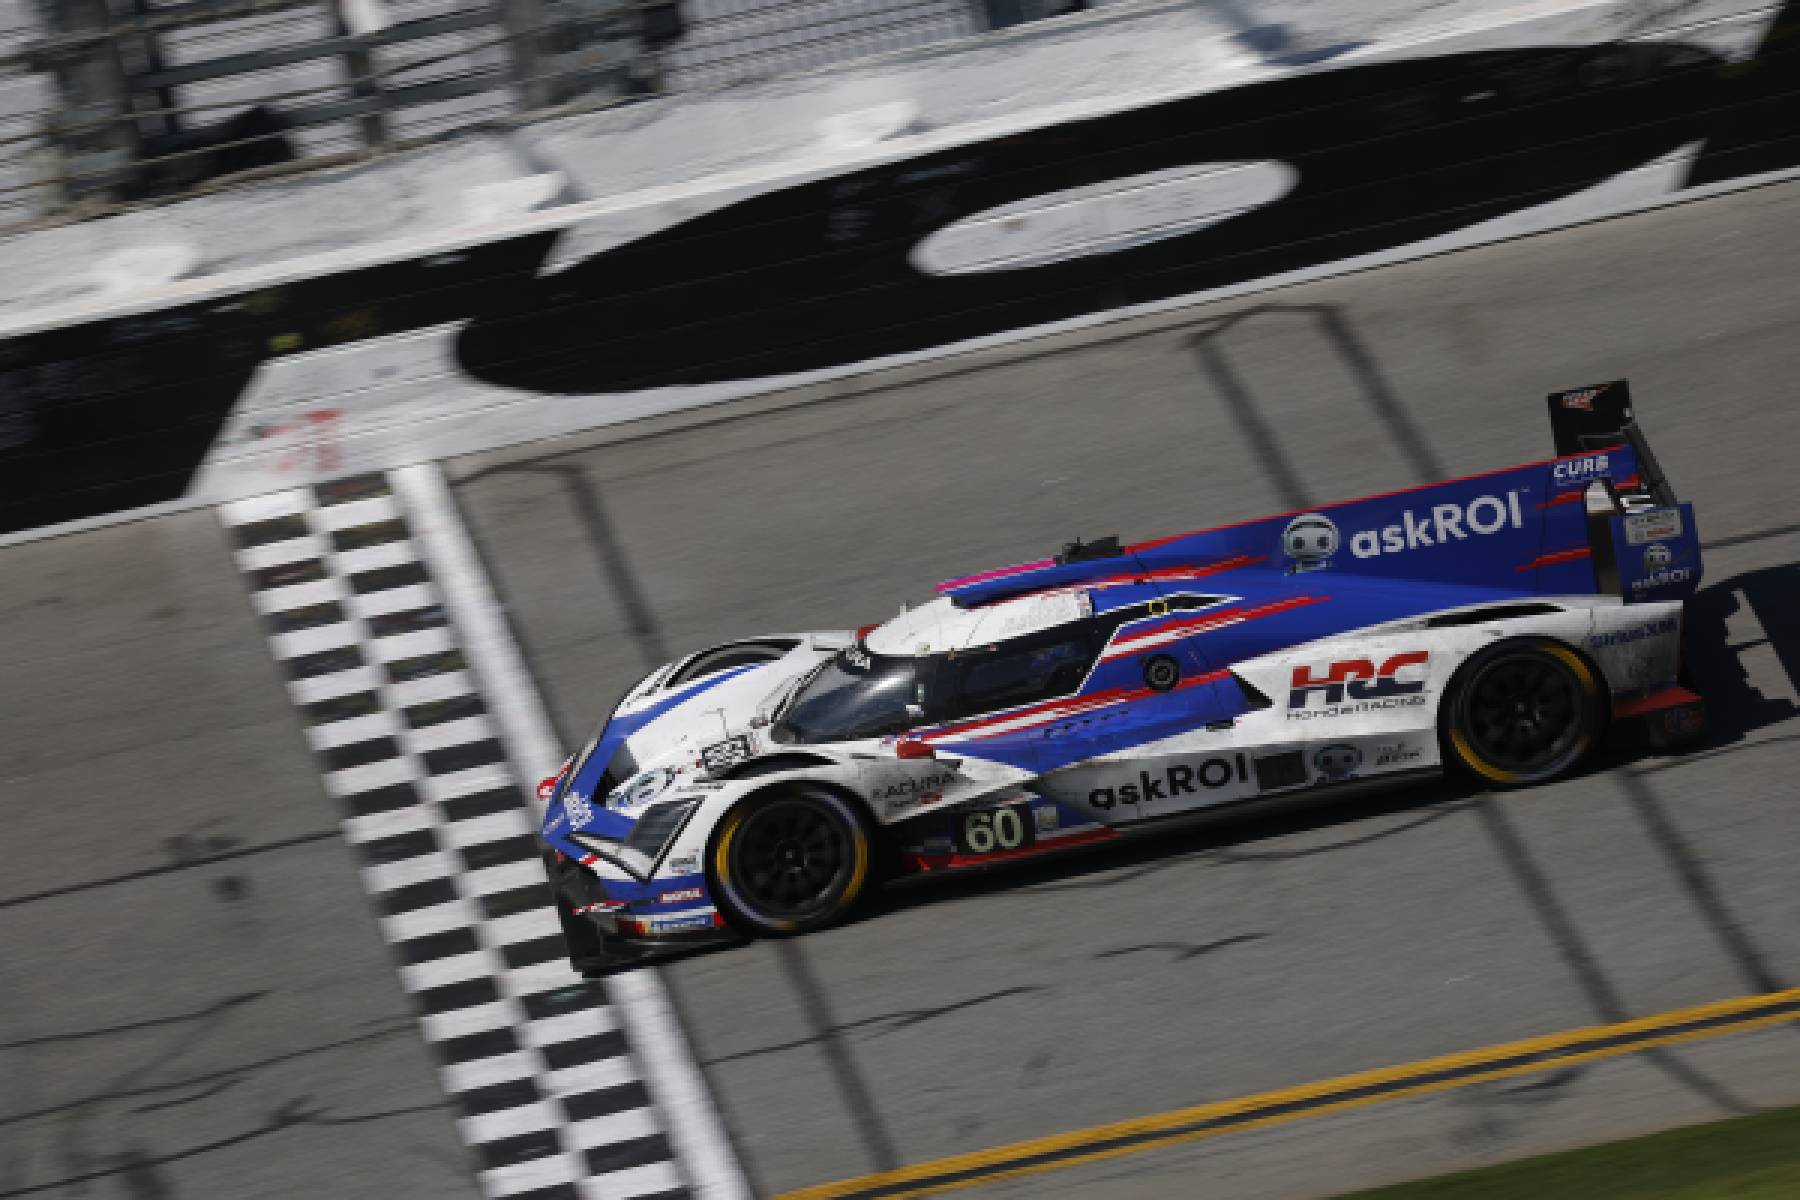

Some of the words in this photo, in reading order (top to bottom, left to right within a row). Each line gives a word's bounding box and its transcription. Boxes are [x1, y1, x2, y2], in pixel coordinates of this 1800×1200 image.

[1350, 491, 1523, 559] askROI
[1289, 651, 1429, 708] HRC
[1088, 752, 1250, 811] askROI
[965, 809, 1024, 852] 60
